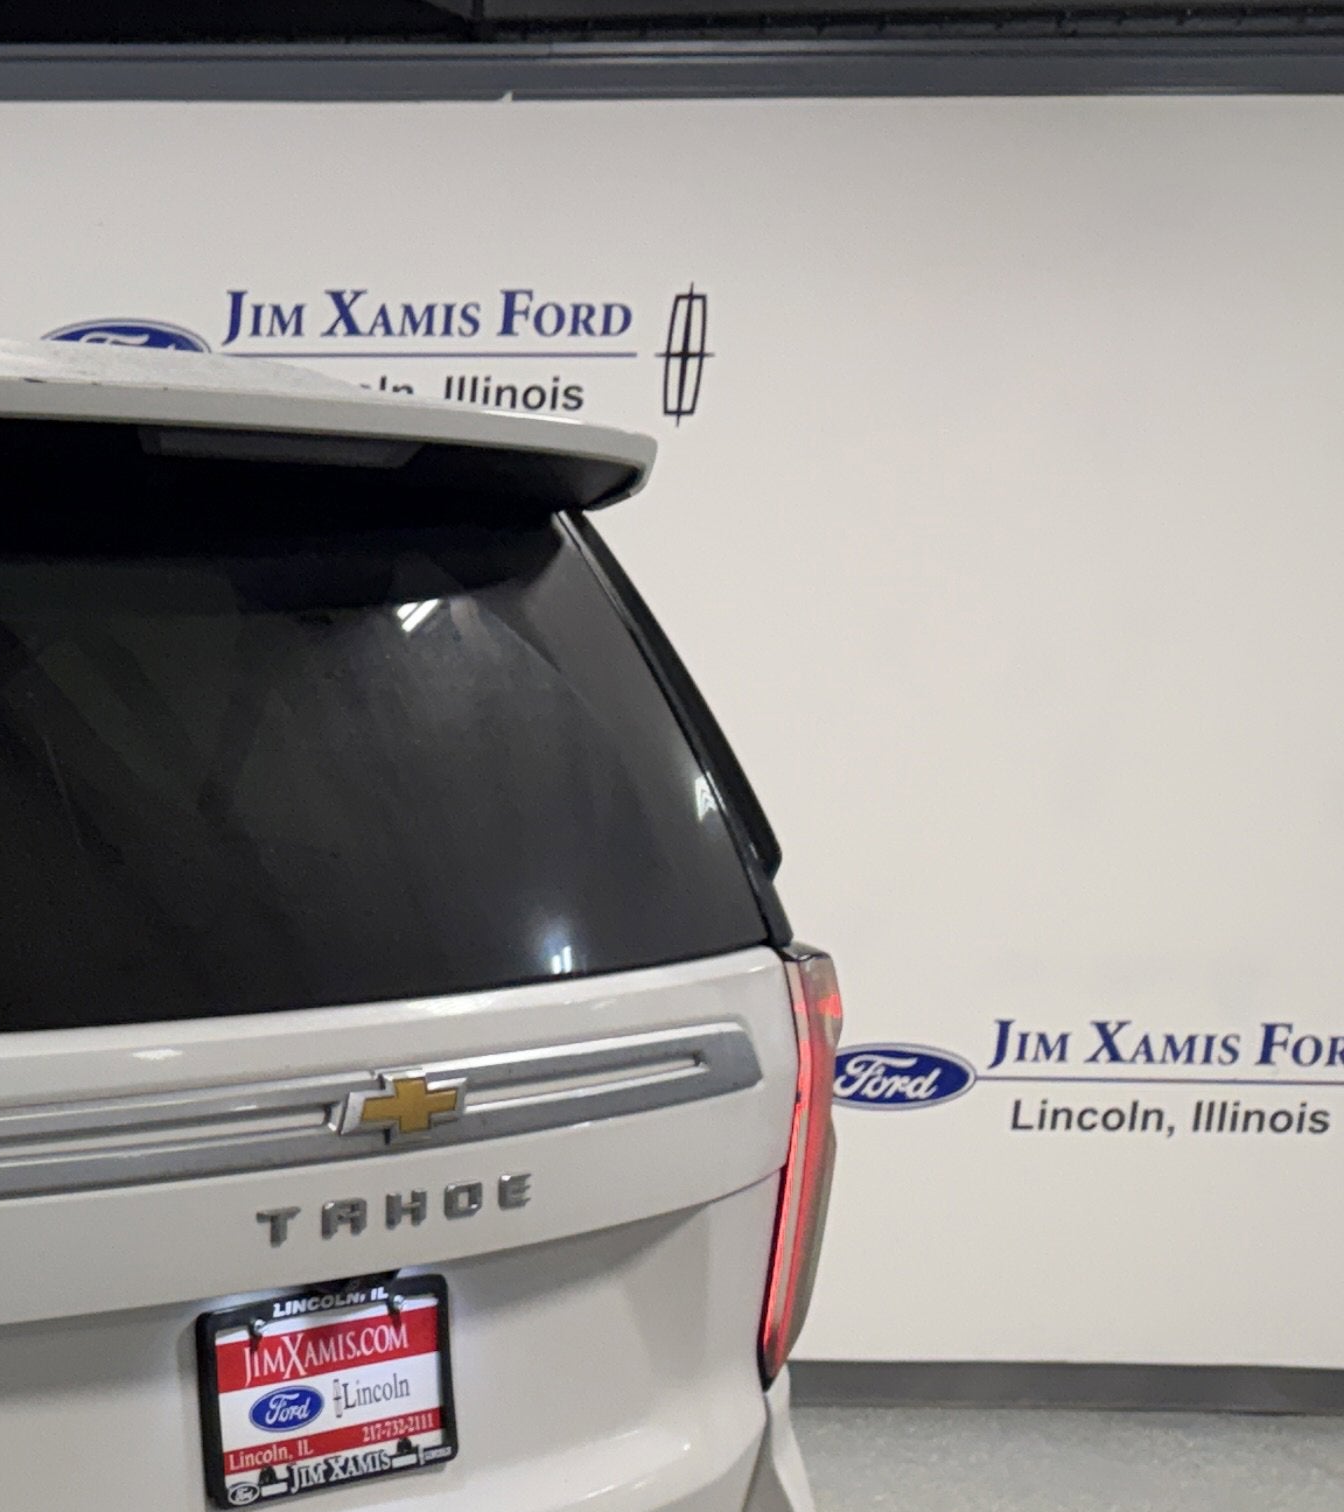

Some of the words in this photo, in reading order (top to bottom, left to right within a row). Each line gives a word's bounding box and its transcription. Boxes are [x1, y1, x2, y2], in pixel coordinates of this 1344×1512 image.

[221, 290, 305, 346] JIM
[320, 290, 480, 338] XAMIS
[495, 290, 633, 337] FORD
[443, 374, 584, 411] Illinois
[987, 1019, 1072, 1069] JIM
[1085, 1020, 1240, 1066] XAMIS
[1255, 1023, 1344, 1068] FOR
[1011, 1099, 1176, 1137] Lincoln,
[1191, 1101, 1330, 1134] Illinois
[256, 1173, 532, 1248] TAHOE
[370, 1286, 389, 1301] IL
[342, 1373, 410, 1410] Lincoln
[297, 1439, 314, 1456] IL
[290, 1463, 326, 1494] JIM
[329, 1452, 391, 1482] XAMIS
